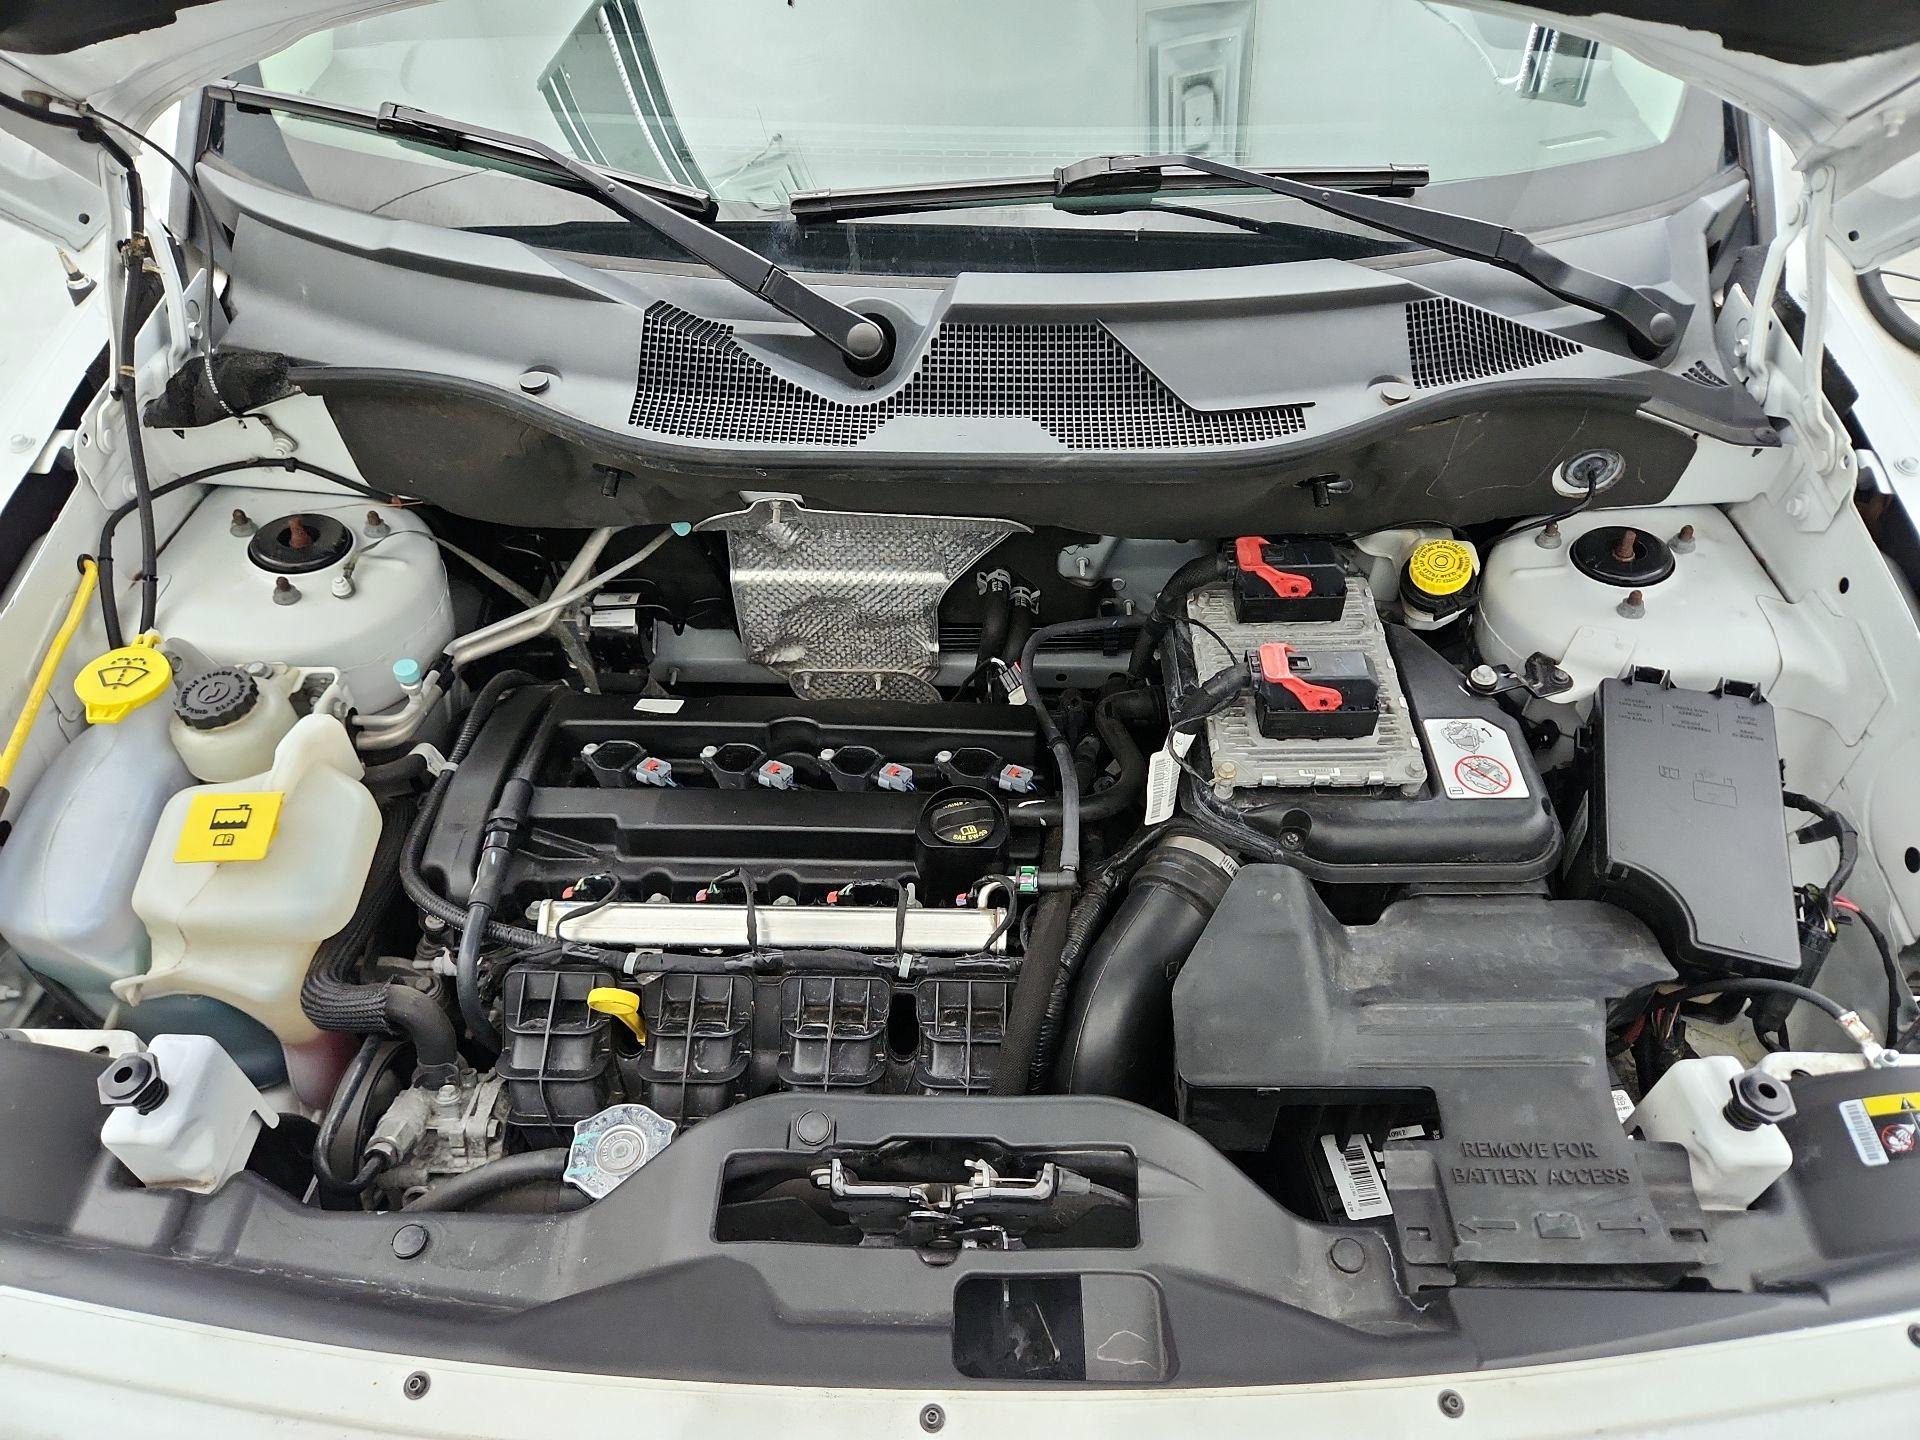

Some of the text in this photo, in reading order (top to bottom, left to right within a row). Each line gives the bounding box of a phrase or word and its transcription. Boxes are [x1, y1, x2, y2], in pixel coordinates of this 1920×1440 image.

[1461, 1141, 1600, 1159] REMOVE FOR
[1451, 1167, 1631, 1185] BATTERY ACCESS
